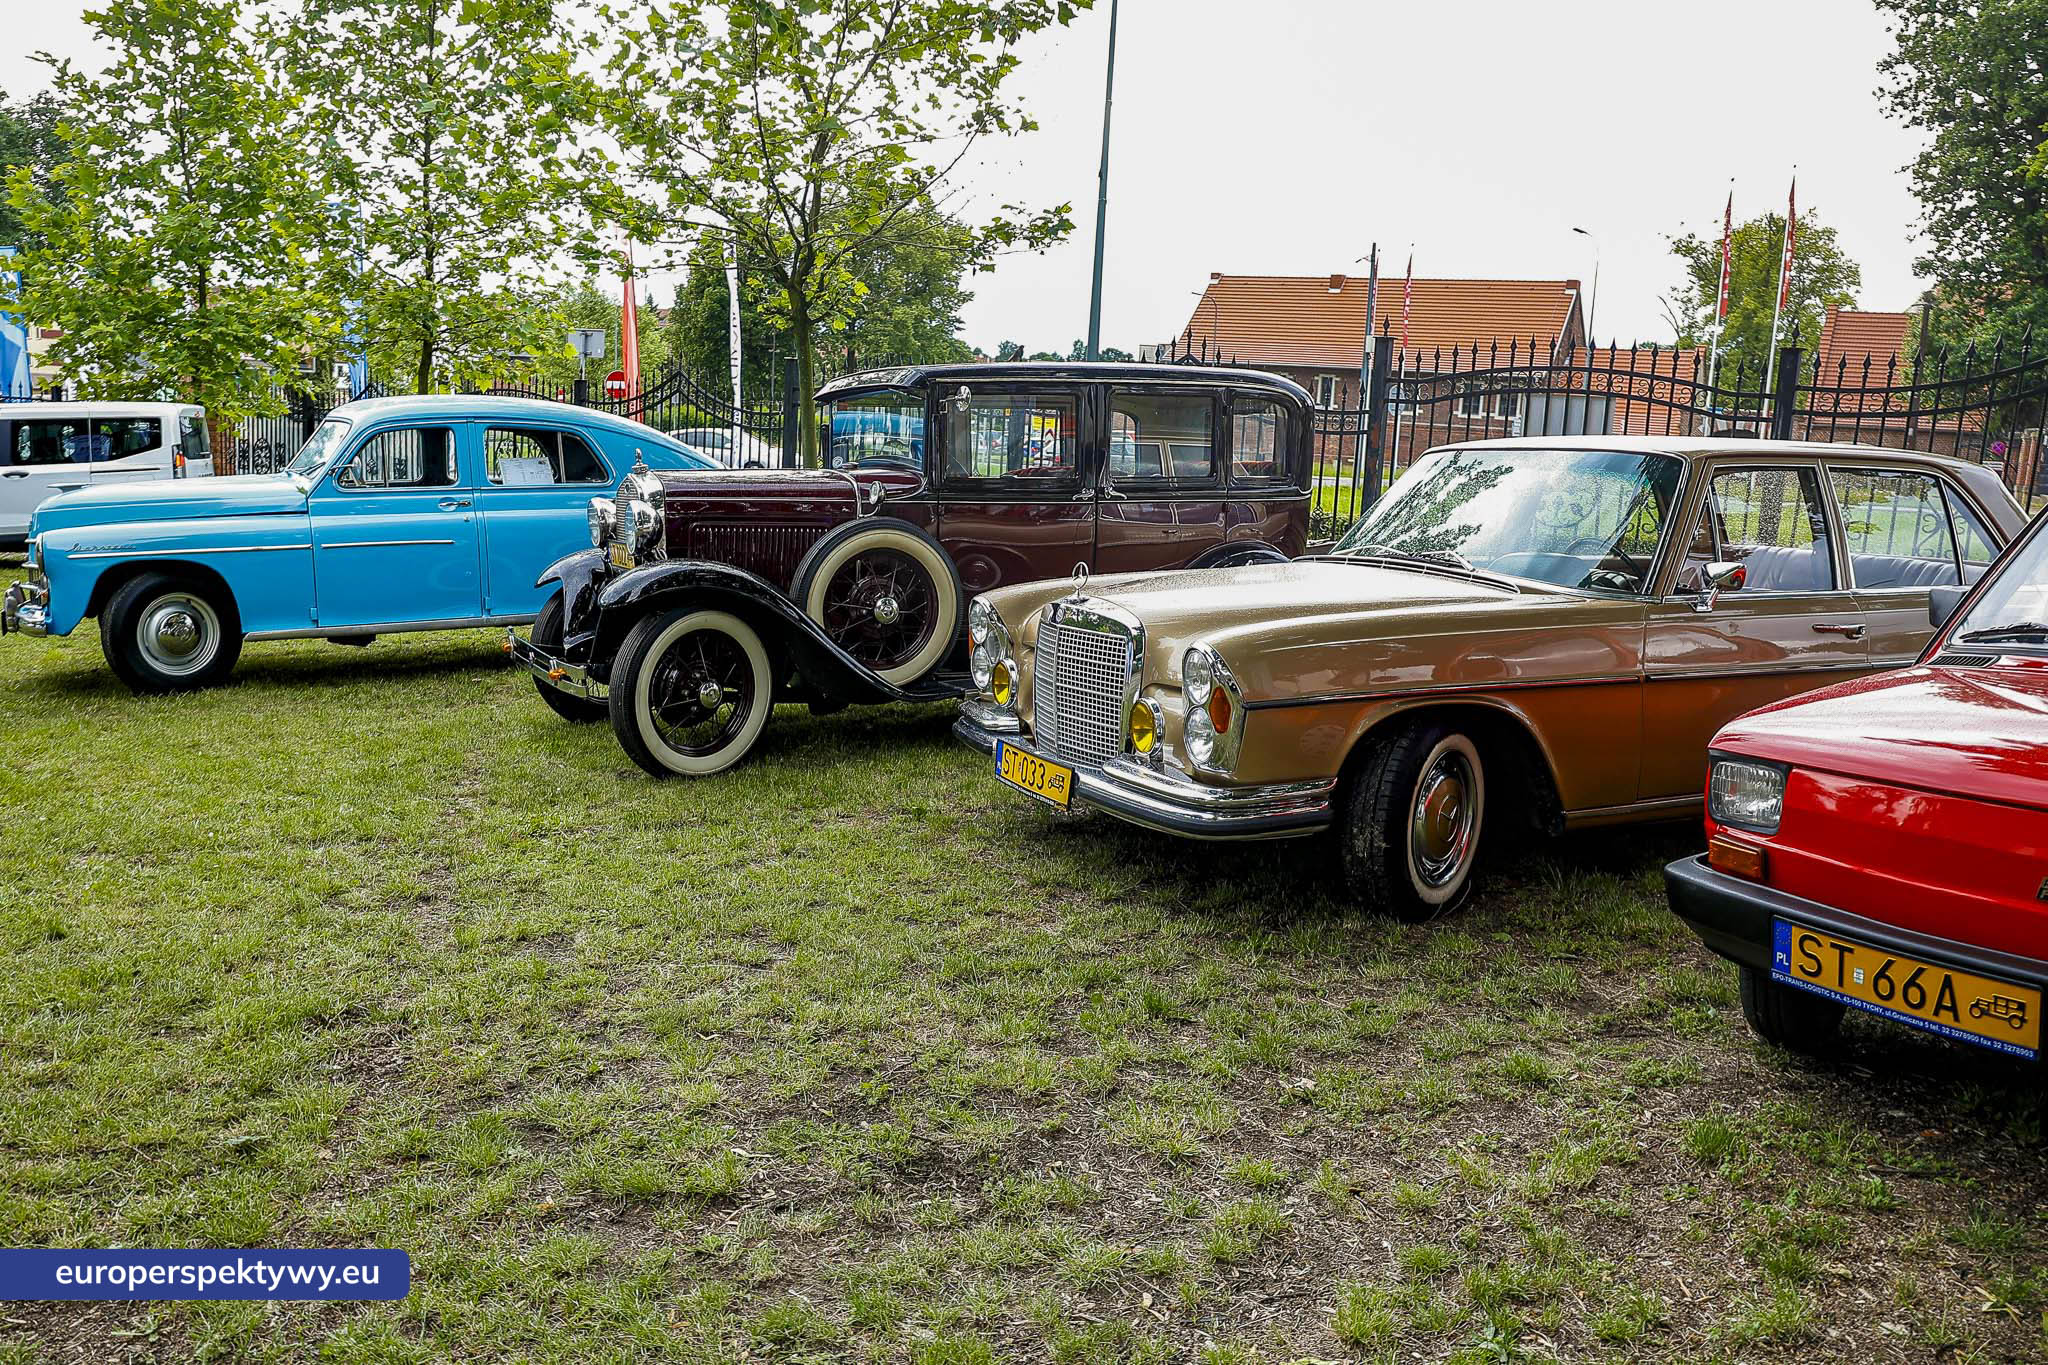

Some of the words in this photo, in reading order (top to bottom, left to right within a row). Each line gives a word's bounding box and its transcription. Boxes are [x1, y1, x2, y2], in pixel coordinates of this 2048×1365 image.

[1003, 748, 1018, 778] ST
[1021, 756, 1046, 790] 033
[1776, 951, 1790, 966] PL
[1798, 933, 1855, 988] ST
[1872, 957, 1961, 1023] 66A
